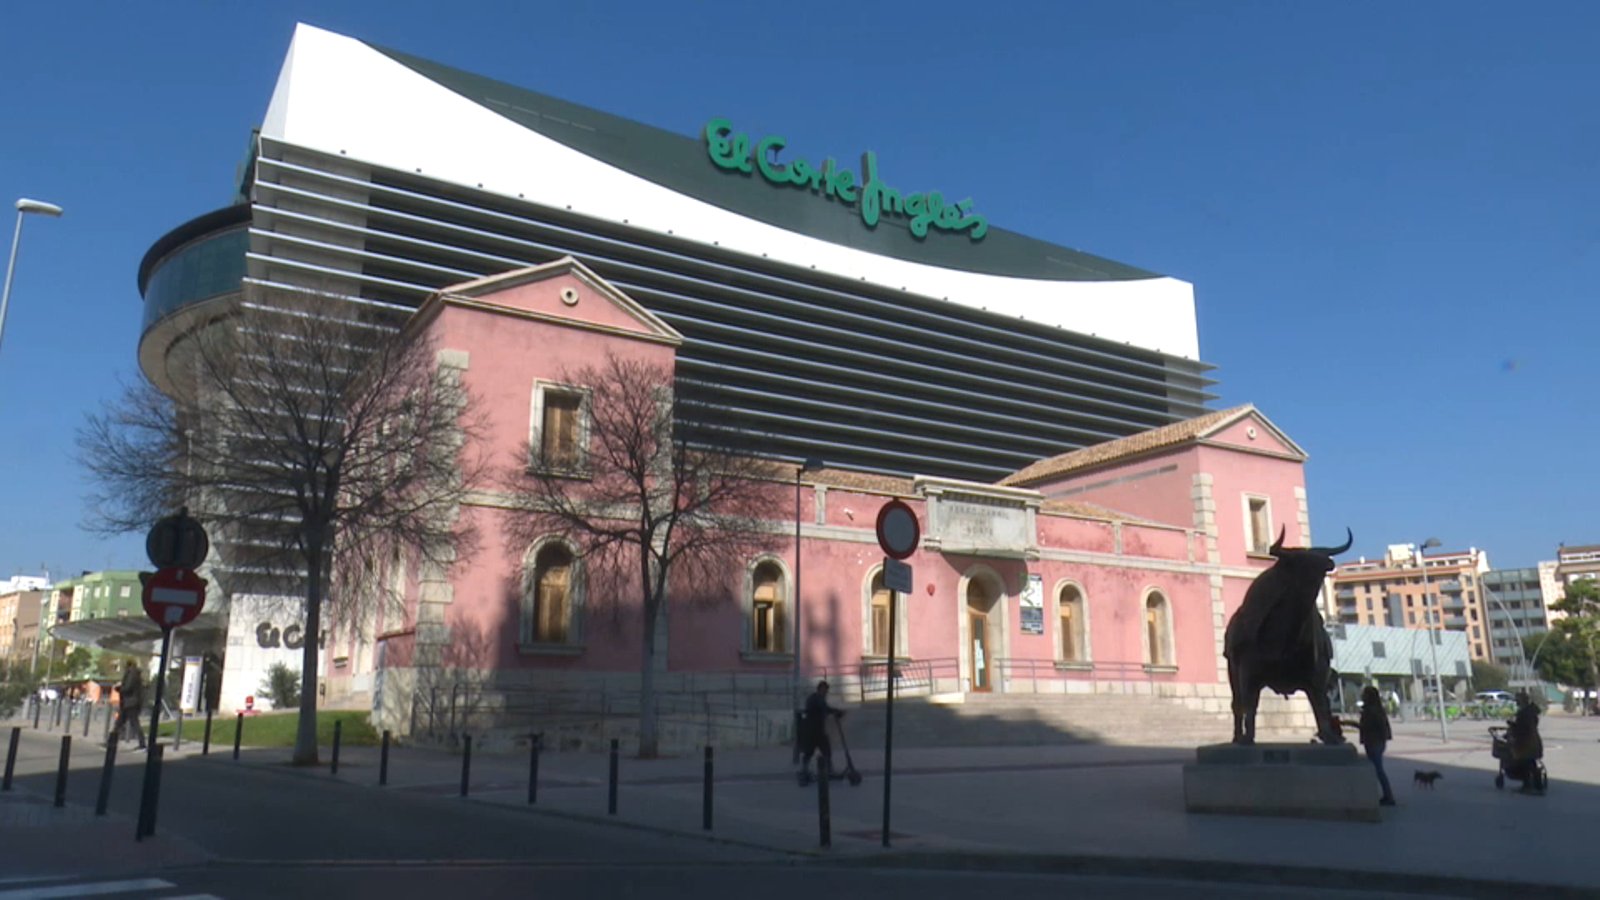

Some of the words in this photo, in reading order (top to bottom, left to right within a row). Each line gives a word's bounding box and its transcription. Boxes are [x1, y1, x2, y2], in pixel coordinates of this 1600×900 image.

[704, 117, 752, 172] El
[756, 136, 857, 202] Corte
[861, 150, 987, 239] Inglés
